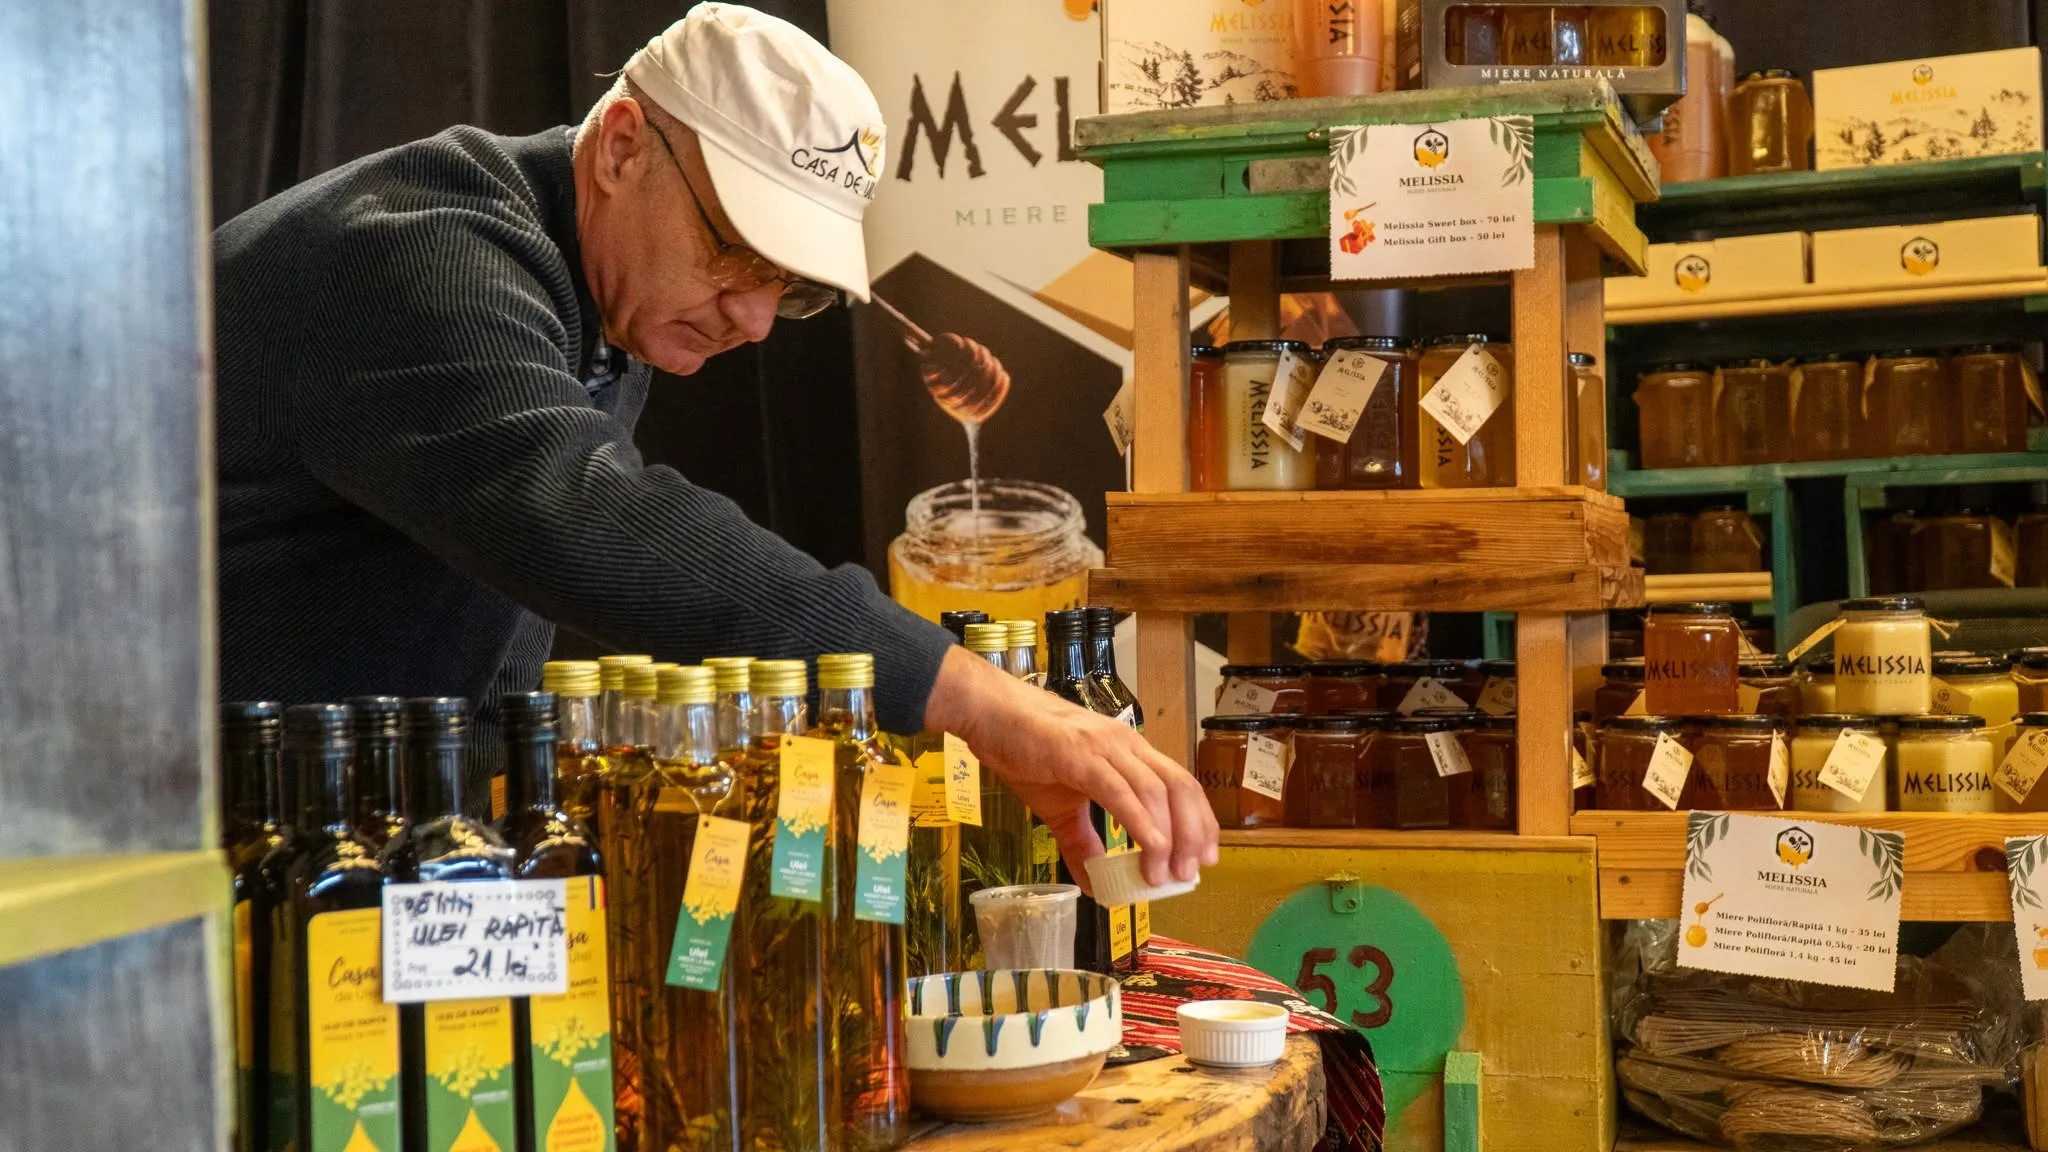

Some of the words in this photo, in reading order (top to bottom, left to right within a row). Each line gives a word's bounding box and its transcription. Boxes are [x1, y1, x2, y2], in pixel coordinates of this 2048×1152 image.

[1329, 0, 1354, 44] SIA
[1481, 69, 1531, 78] MIERE
[896, 70, 1087, 182] MEL
[791, 149, 840, 182] CASA
[844, 171, 863, 194] DE
[1399, 174, 1464, 187] MELISSIA
[955, 205, 1066, 226] MIERE
[1384, 221, 1425, 231] Melissia
[1428, 219, 1456, 228] Sweet
[1460, 217, 1477, 226] box
[1487, 215, 1500, 224] 70
[1502, 214, 1515, 223] lei
[1384, 236, 1425, 246] Melissia
[1428, 235, 1446, 244] Gift
[1450, 234, 1467, 243] box
[1477, 232, 1489, 241] 50
[1492, 231, 1505, 240] lei
[1250, 380, 1270, 470] MELISSIA
[1839, 653, 1925, 676] MELISSIA
[1904, 772, 1992, 795] MELISSIA
[873, 792, 897, 808] Casa
[704, 848, 729, 865] Casa
[790, 859, 808, 870] Ulei
[873, 883, 891, 894] Ulei
[1758, 870, 1828, 888] MELISSIA
[413, 923, 467, 946] ULEI
[1716, 911, 1744, 921] Miere
[1836, 926, 1848, 935] kg
[1858, 928, 1870, 936] 35
[1873, 929, 1886, 938] lei
[566, 932, 588, 949] sa
[1715, 926, 1743, 937] Miere
[1825, 939, 1853, 951] 0,5kg
[1863, 944, 1875, 953] 20
[1878, 945, 1891, 954] lei
[453, 949, 492, 978] 21
[505, 949, 528, 978] lei
[689, 946, 709, 959] Ulei
[1713, 941, 1741, 951] Miere
[1789, 951, 1803, 959] 1,4
[1807, 952, 1819, 962] kg
[1829, 956, 1841, 964] 45
[1844, 957, 1857, 966] lei
[328, 956, 381, 989] Casa
[1296, 945, 1394, 1028] 53
